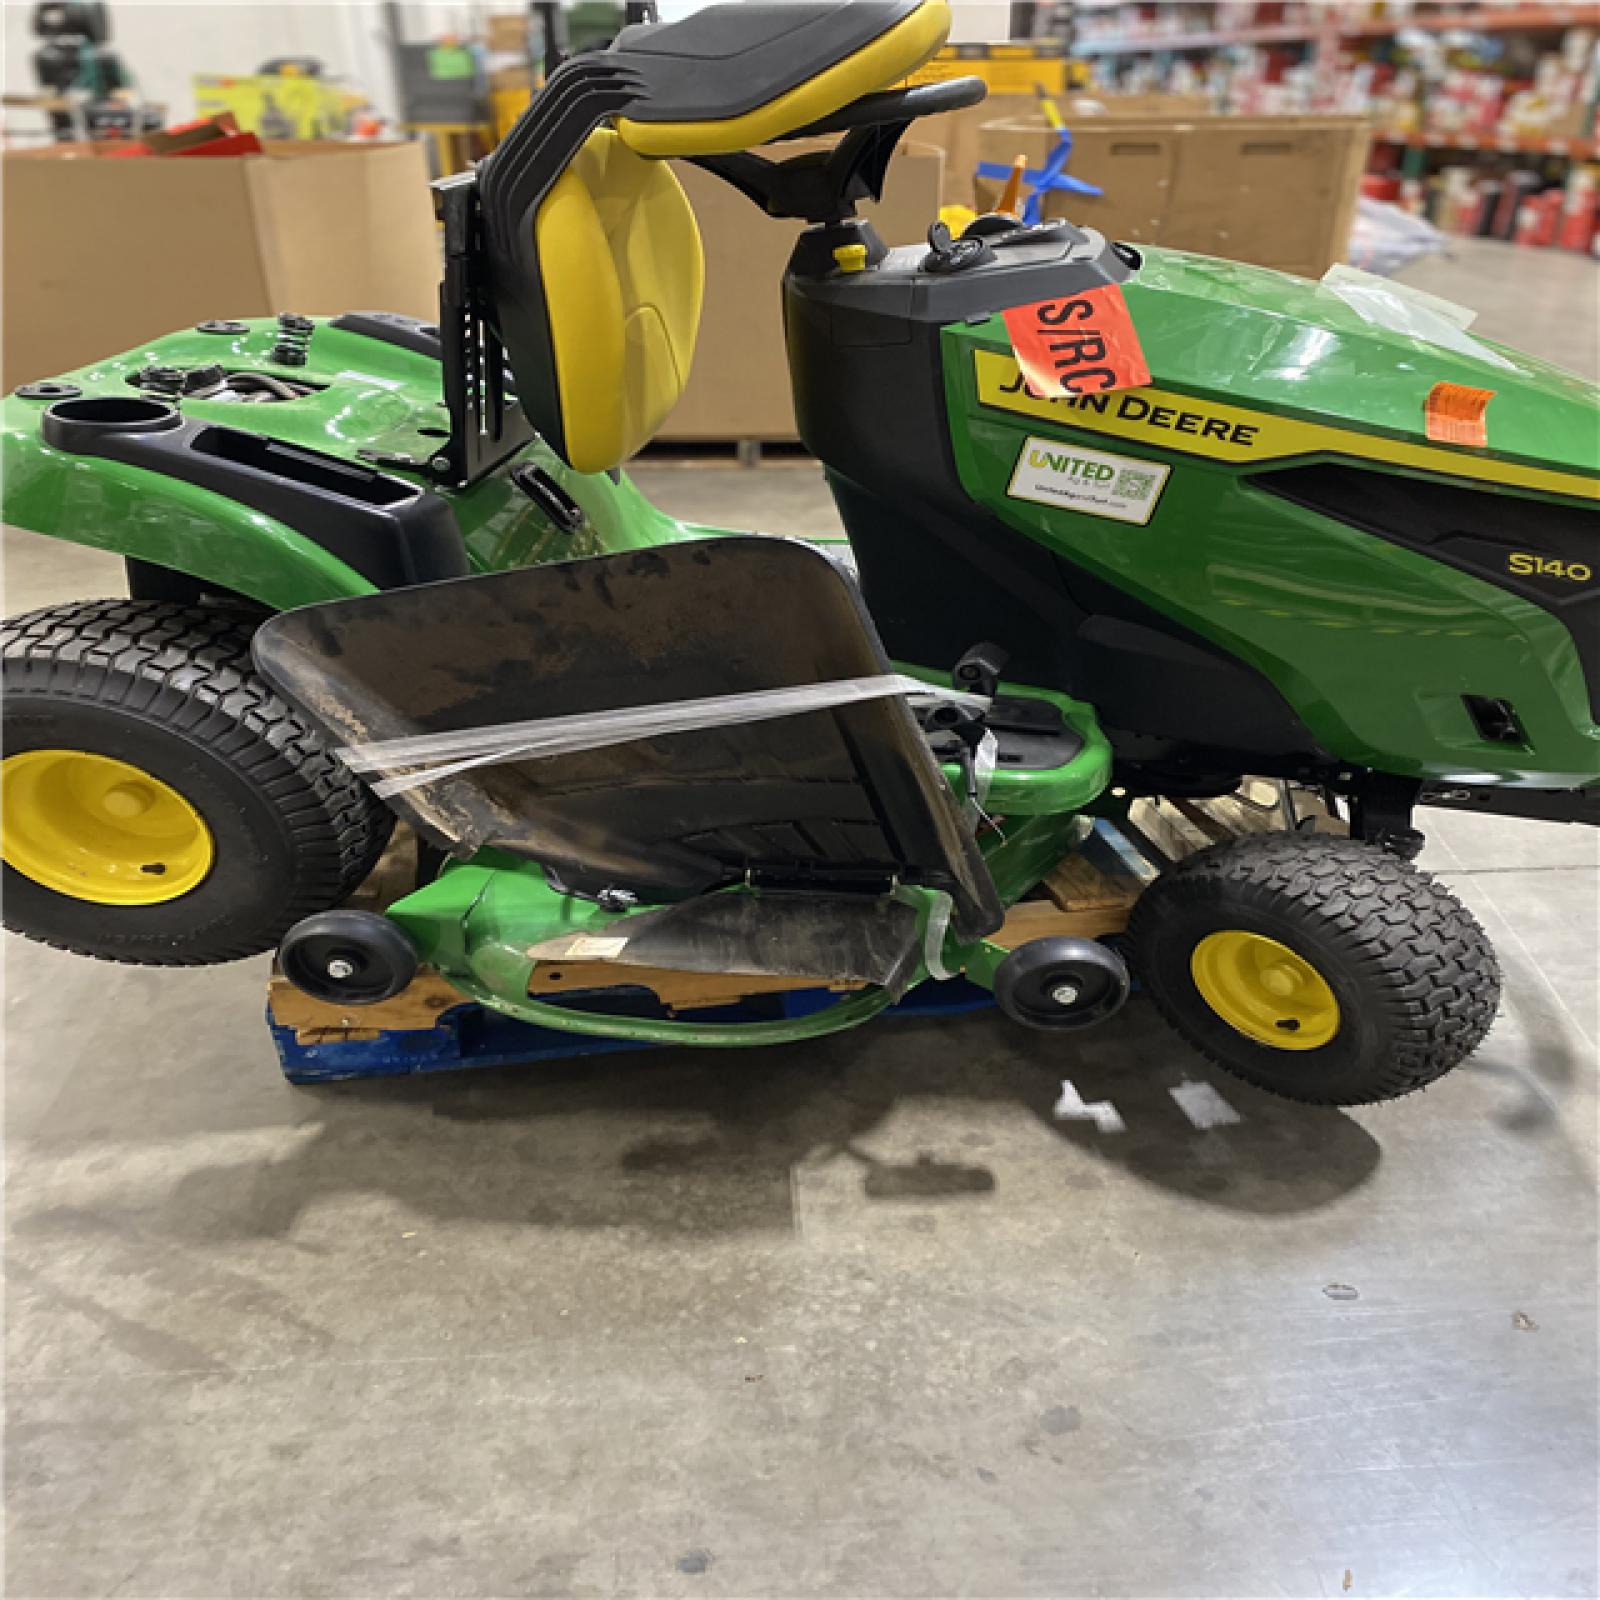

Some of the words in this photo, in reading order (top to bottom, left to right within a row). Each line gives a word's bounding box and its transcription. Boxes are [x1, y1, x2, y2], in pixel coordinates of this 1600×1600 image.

[1037, 300, 1116, 393] S/RC
[999, 370, 1110, 413] JN
[1117, 395, 1259, 445] DEERE
[1028, 449, 1114, 480] UNITED
[1509, 553, 1591, 581] S140
